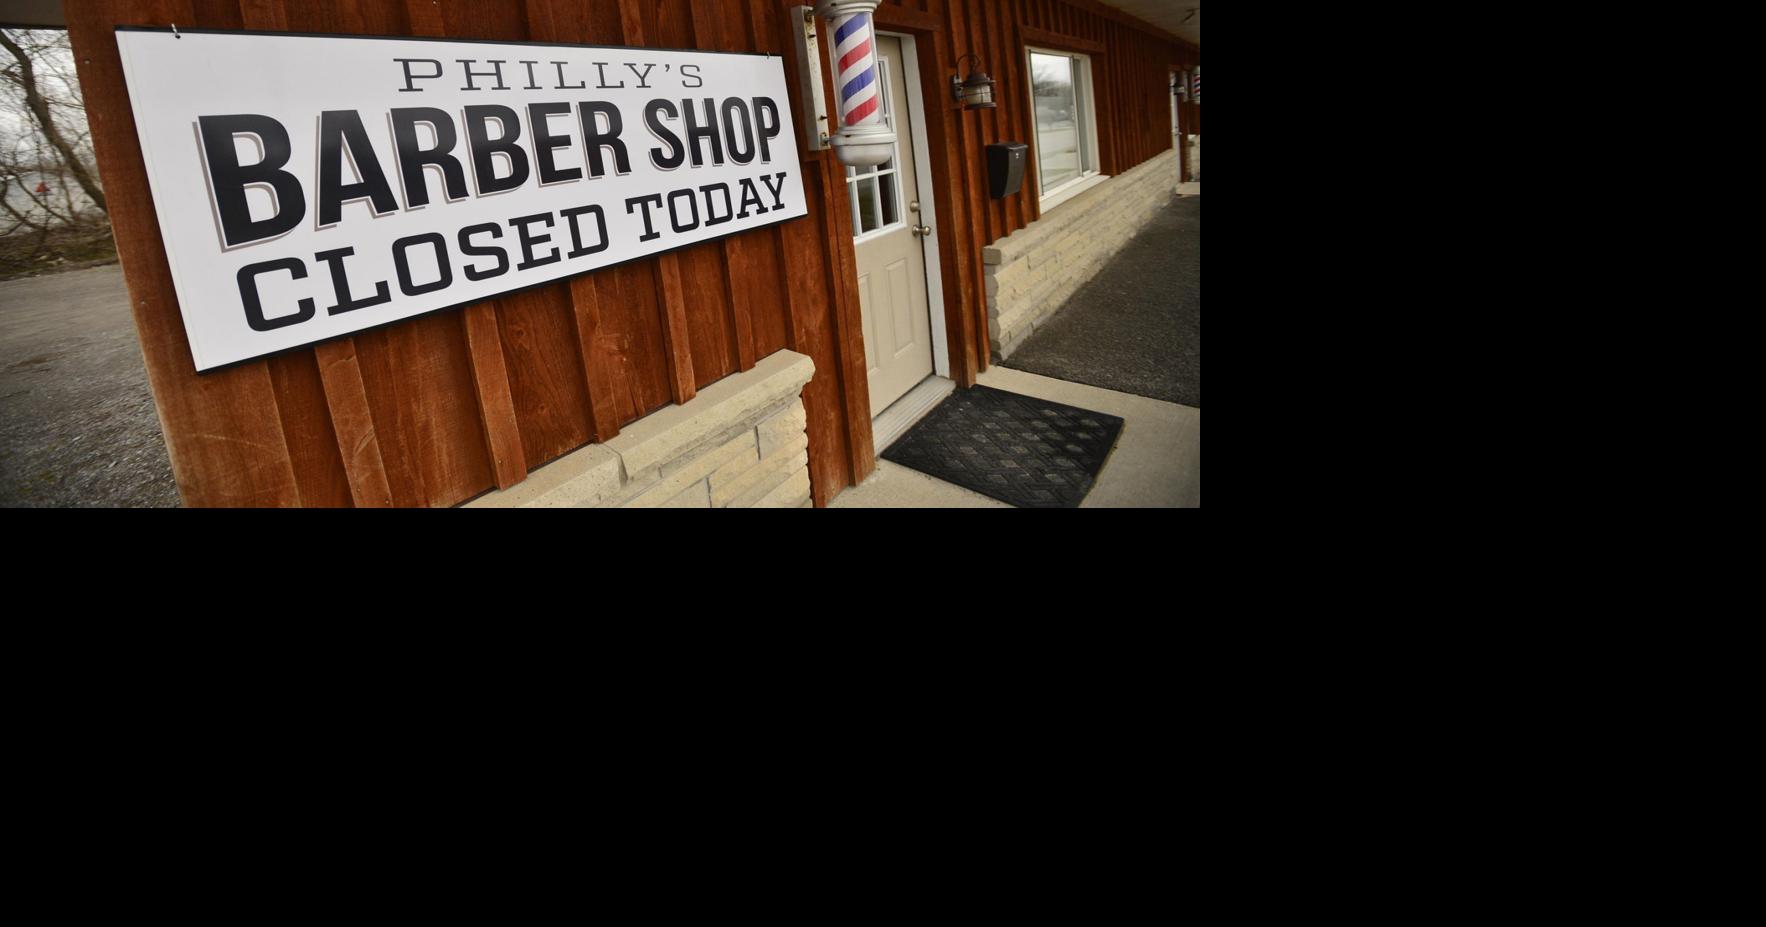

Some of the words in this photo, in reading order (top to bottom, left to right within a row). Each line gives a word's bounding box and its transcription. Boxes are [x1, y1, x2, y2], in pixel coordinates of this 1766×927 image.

[393, 58, 703, 92] PHILLY'S
[193, 99, 631, 253] BARBER
[643, 96, 781, 172] SHOP
[236, 203, 610, 332] CLOSED
[625, 172, 787, 243] TODAY
